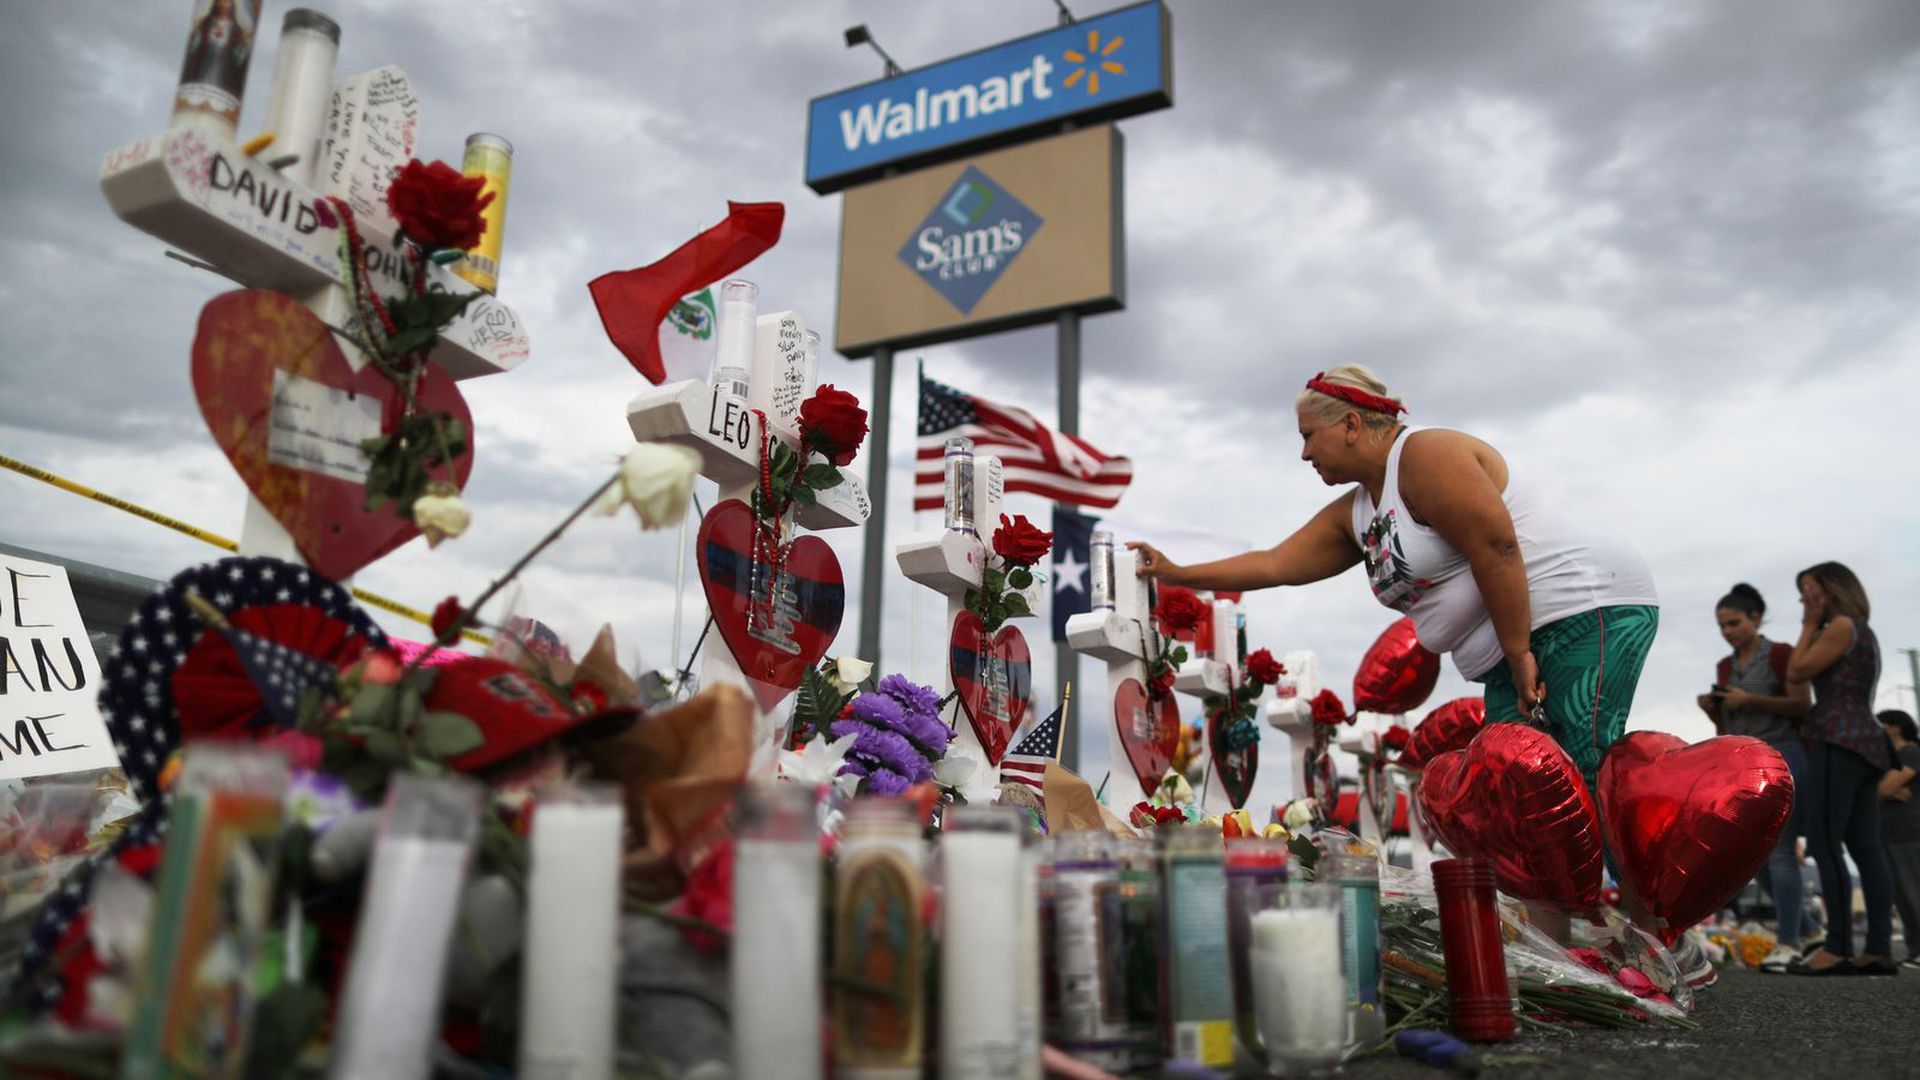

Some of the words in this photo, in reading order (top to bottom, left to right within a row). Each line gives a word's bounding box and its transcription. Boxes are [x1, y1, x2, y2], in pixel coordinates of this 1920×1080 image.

[840, 55, 1053, 150] Walmart
[208, 151, 319, 234] DAVID
[917, 218, 1022, 271] Sam's
[938, 254, 997, 281] CLUB
[709, 384, 750, 450] LEO
[0, 567, 54, 627] E
